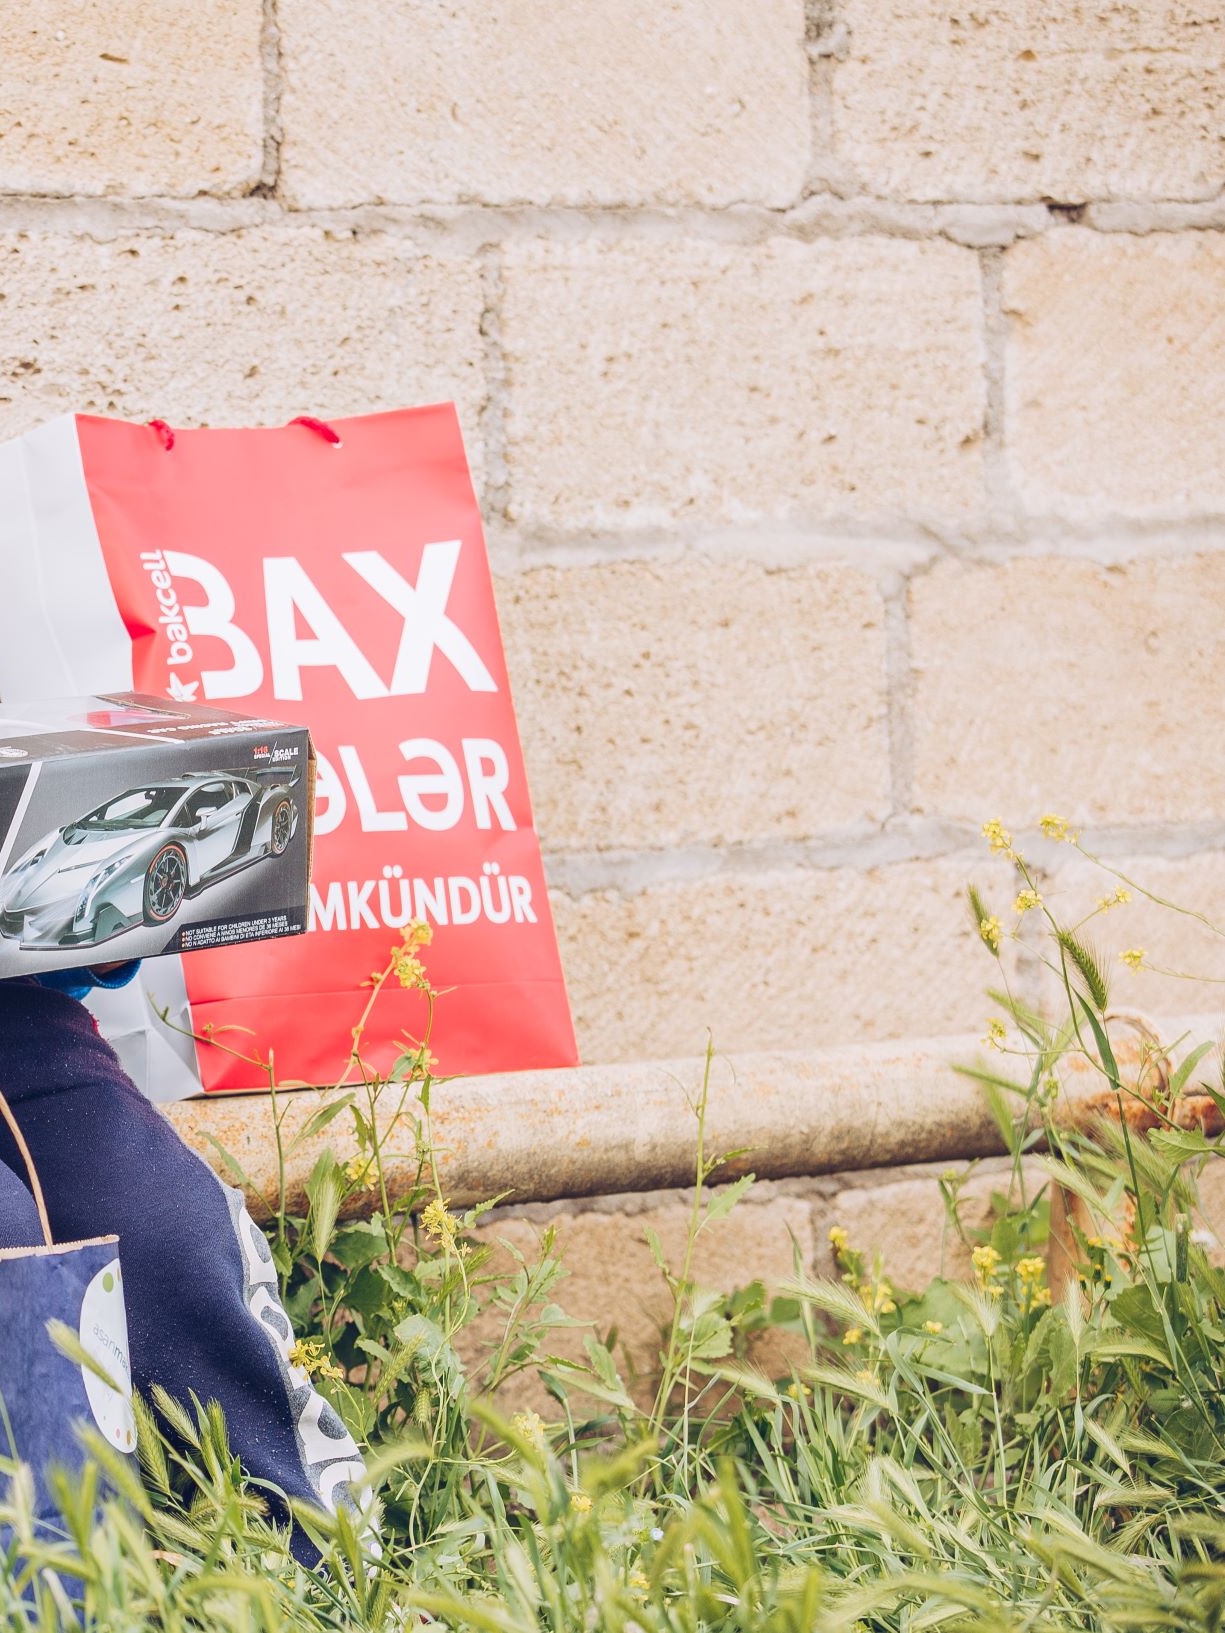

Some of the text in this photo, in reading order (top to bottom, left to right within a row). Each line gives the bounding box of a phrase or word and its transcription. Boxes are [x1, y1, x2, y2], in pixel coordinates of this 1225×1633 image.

[140, 549, 193, 665] bakcell
[163, 540, 498, 700] BAX
[273, 747, 298, 759] SCALE
[251, 918, 267, 926] UNDER
